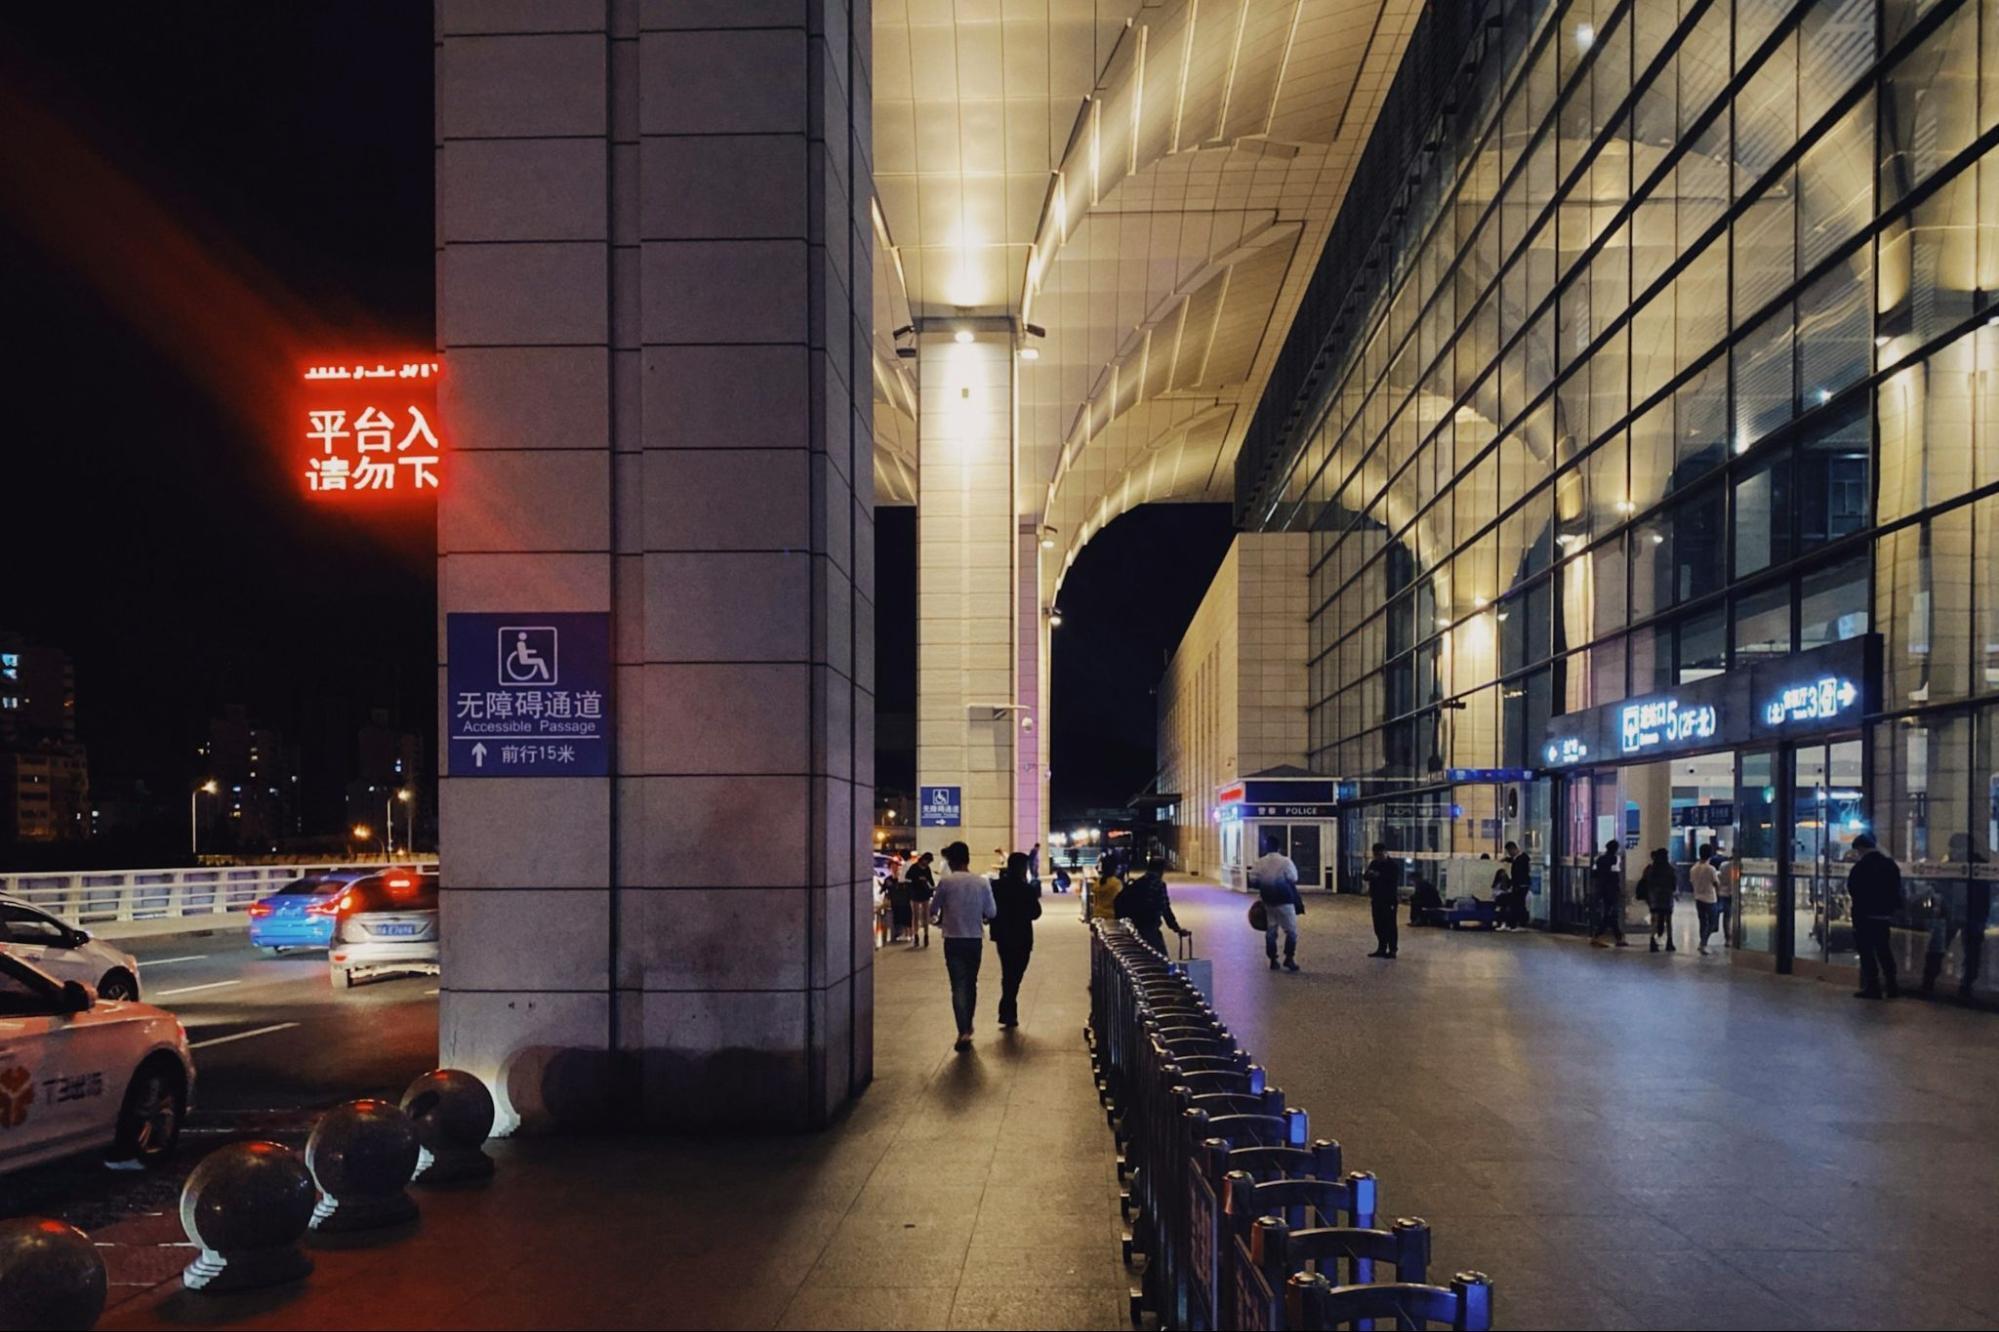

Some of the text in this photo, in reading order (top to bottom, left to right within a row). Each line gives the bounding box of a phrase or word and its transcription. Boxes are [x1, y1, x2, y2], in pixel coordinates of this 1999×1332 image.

[305, 405, 439, 454] 平台入
[304, 455, 439, 491] 请勿下
[457, 690, 602, 719] 无障碍通道
[463, 719, 596, 735] Accessible Passage
[501, 744, 575, 764] 前行15米
[1285, 807, 1317, 815] POLICE
